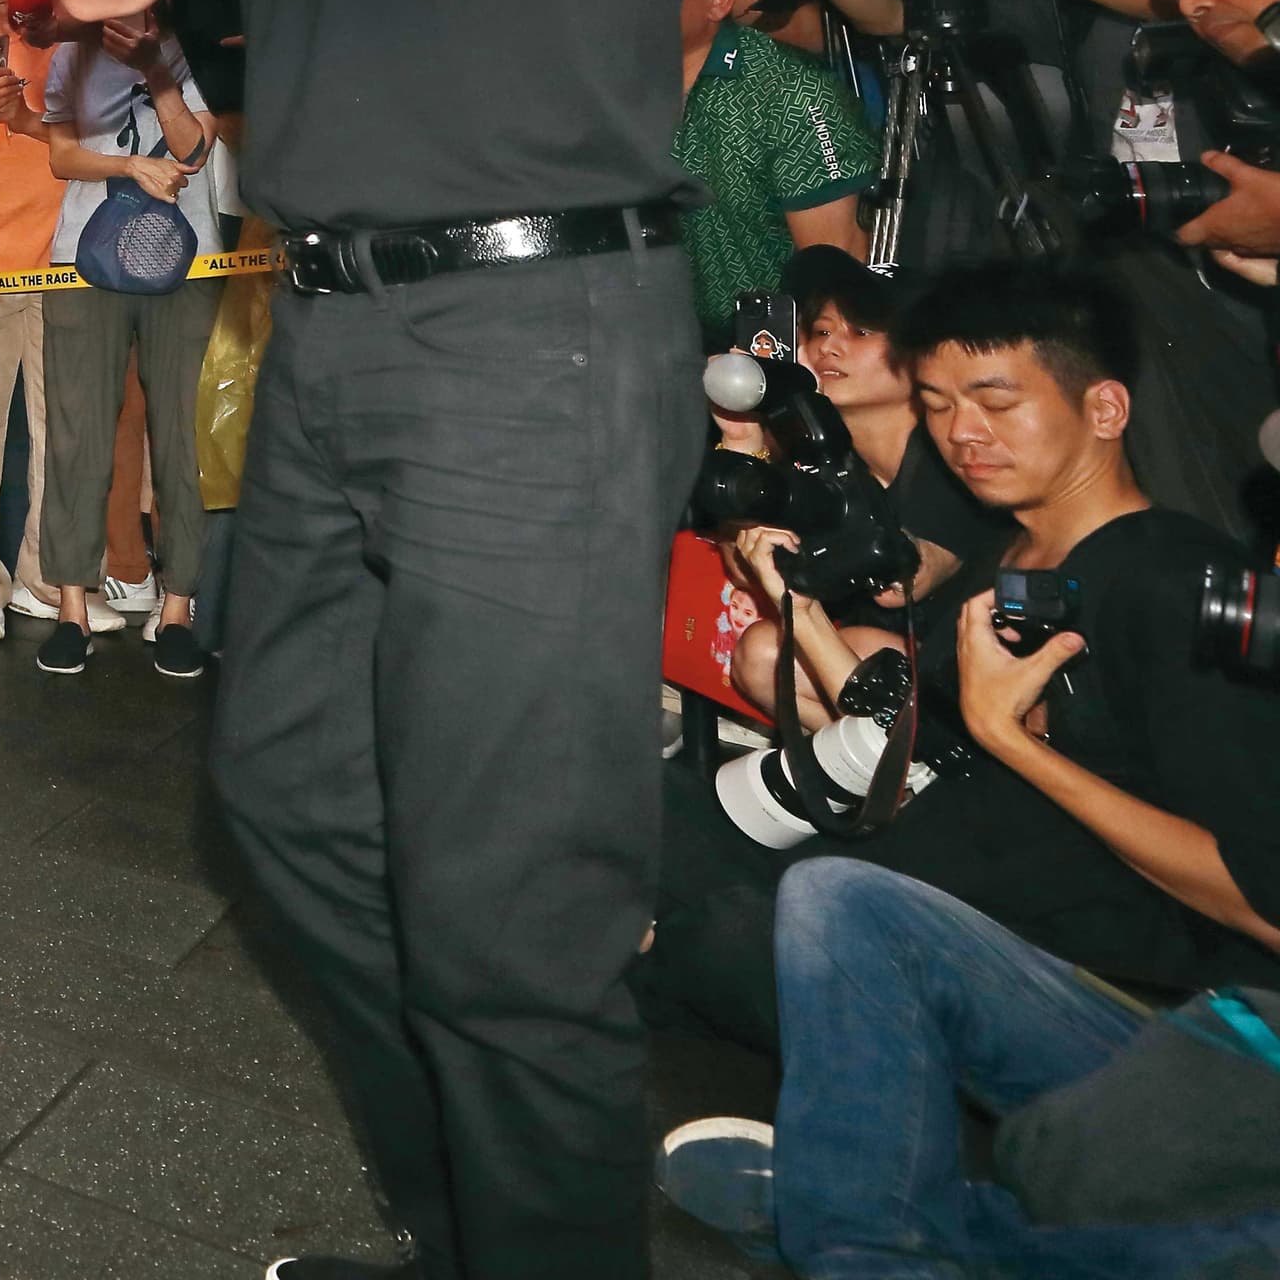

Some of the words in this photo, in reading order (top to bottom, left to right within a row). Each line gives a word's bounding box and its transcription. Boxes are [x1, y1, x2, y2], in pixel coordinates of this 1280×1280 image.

[239, 254, 268, 267] THE
[20, 274, 43, 286] THE
[46, 272, 78, 285] RAGE
